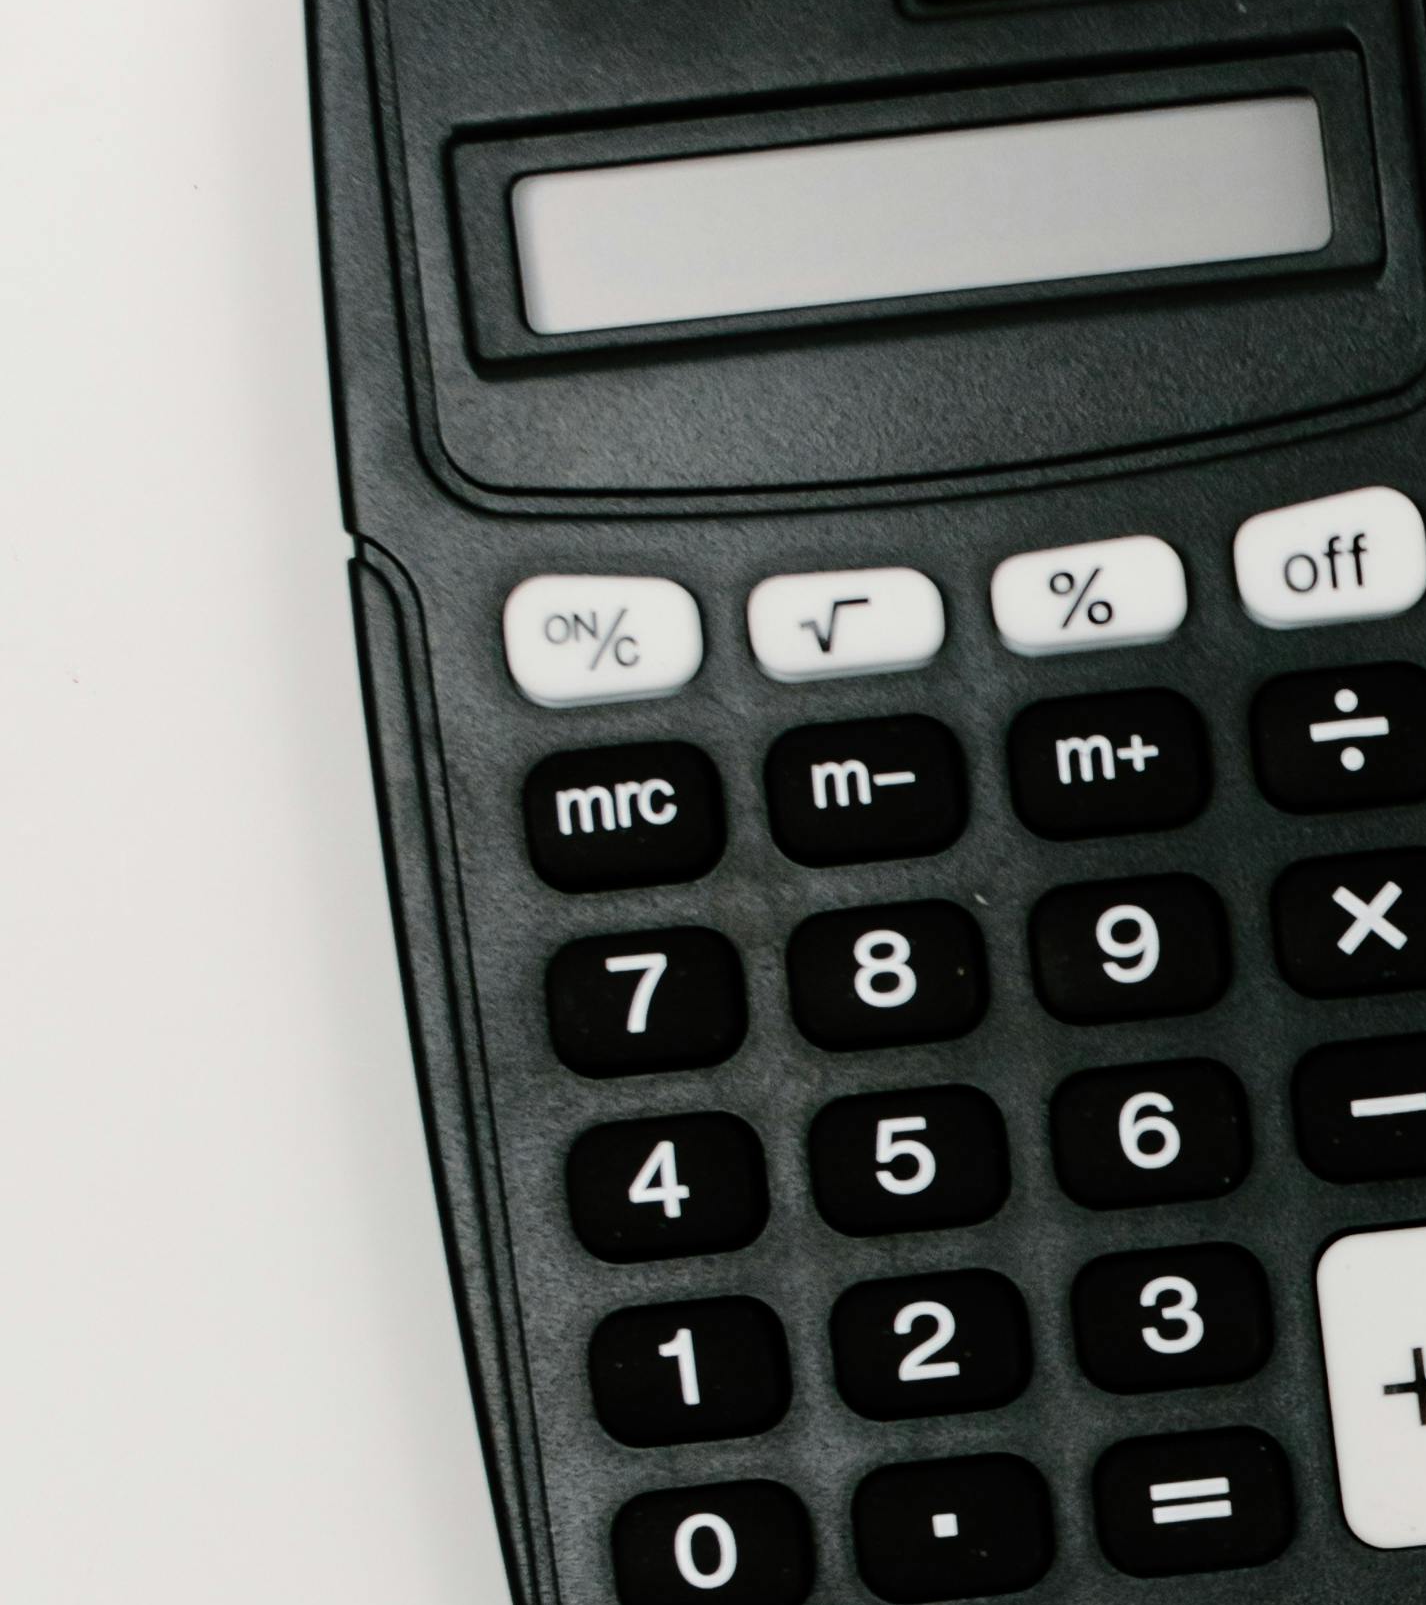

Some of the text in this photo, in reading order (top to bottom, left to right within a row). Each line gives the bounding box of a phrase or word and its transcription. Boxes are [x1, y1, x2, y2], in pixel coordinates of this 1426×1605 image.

[1046, 566, 1117, 632] %
[1281, 531, 1372, 598] off
[1054, 728, 1160, 788] m+
[553, 772, 679, 837] mrc
[851, 928, 919, 1010] 8
[1094, 903, 1162, 986] 9
[605, 953, 670, 1036] 7
[873, 1114, 938, 1197] 5
[1117, 1092, 1183, 1173] 6
[628, 1140, 691, 1222] 4
[895, 1300, 962, 1384] 2
[1137, 1277, 1206, 1356] 3
[655, 1326, 702, 1409] 1
[672, 1512, 739, 1593] 0
